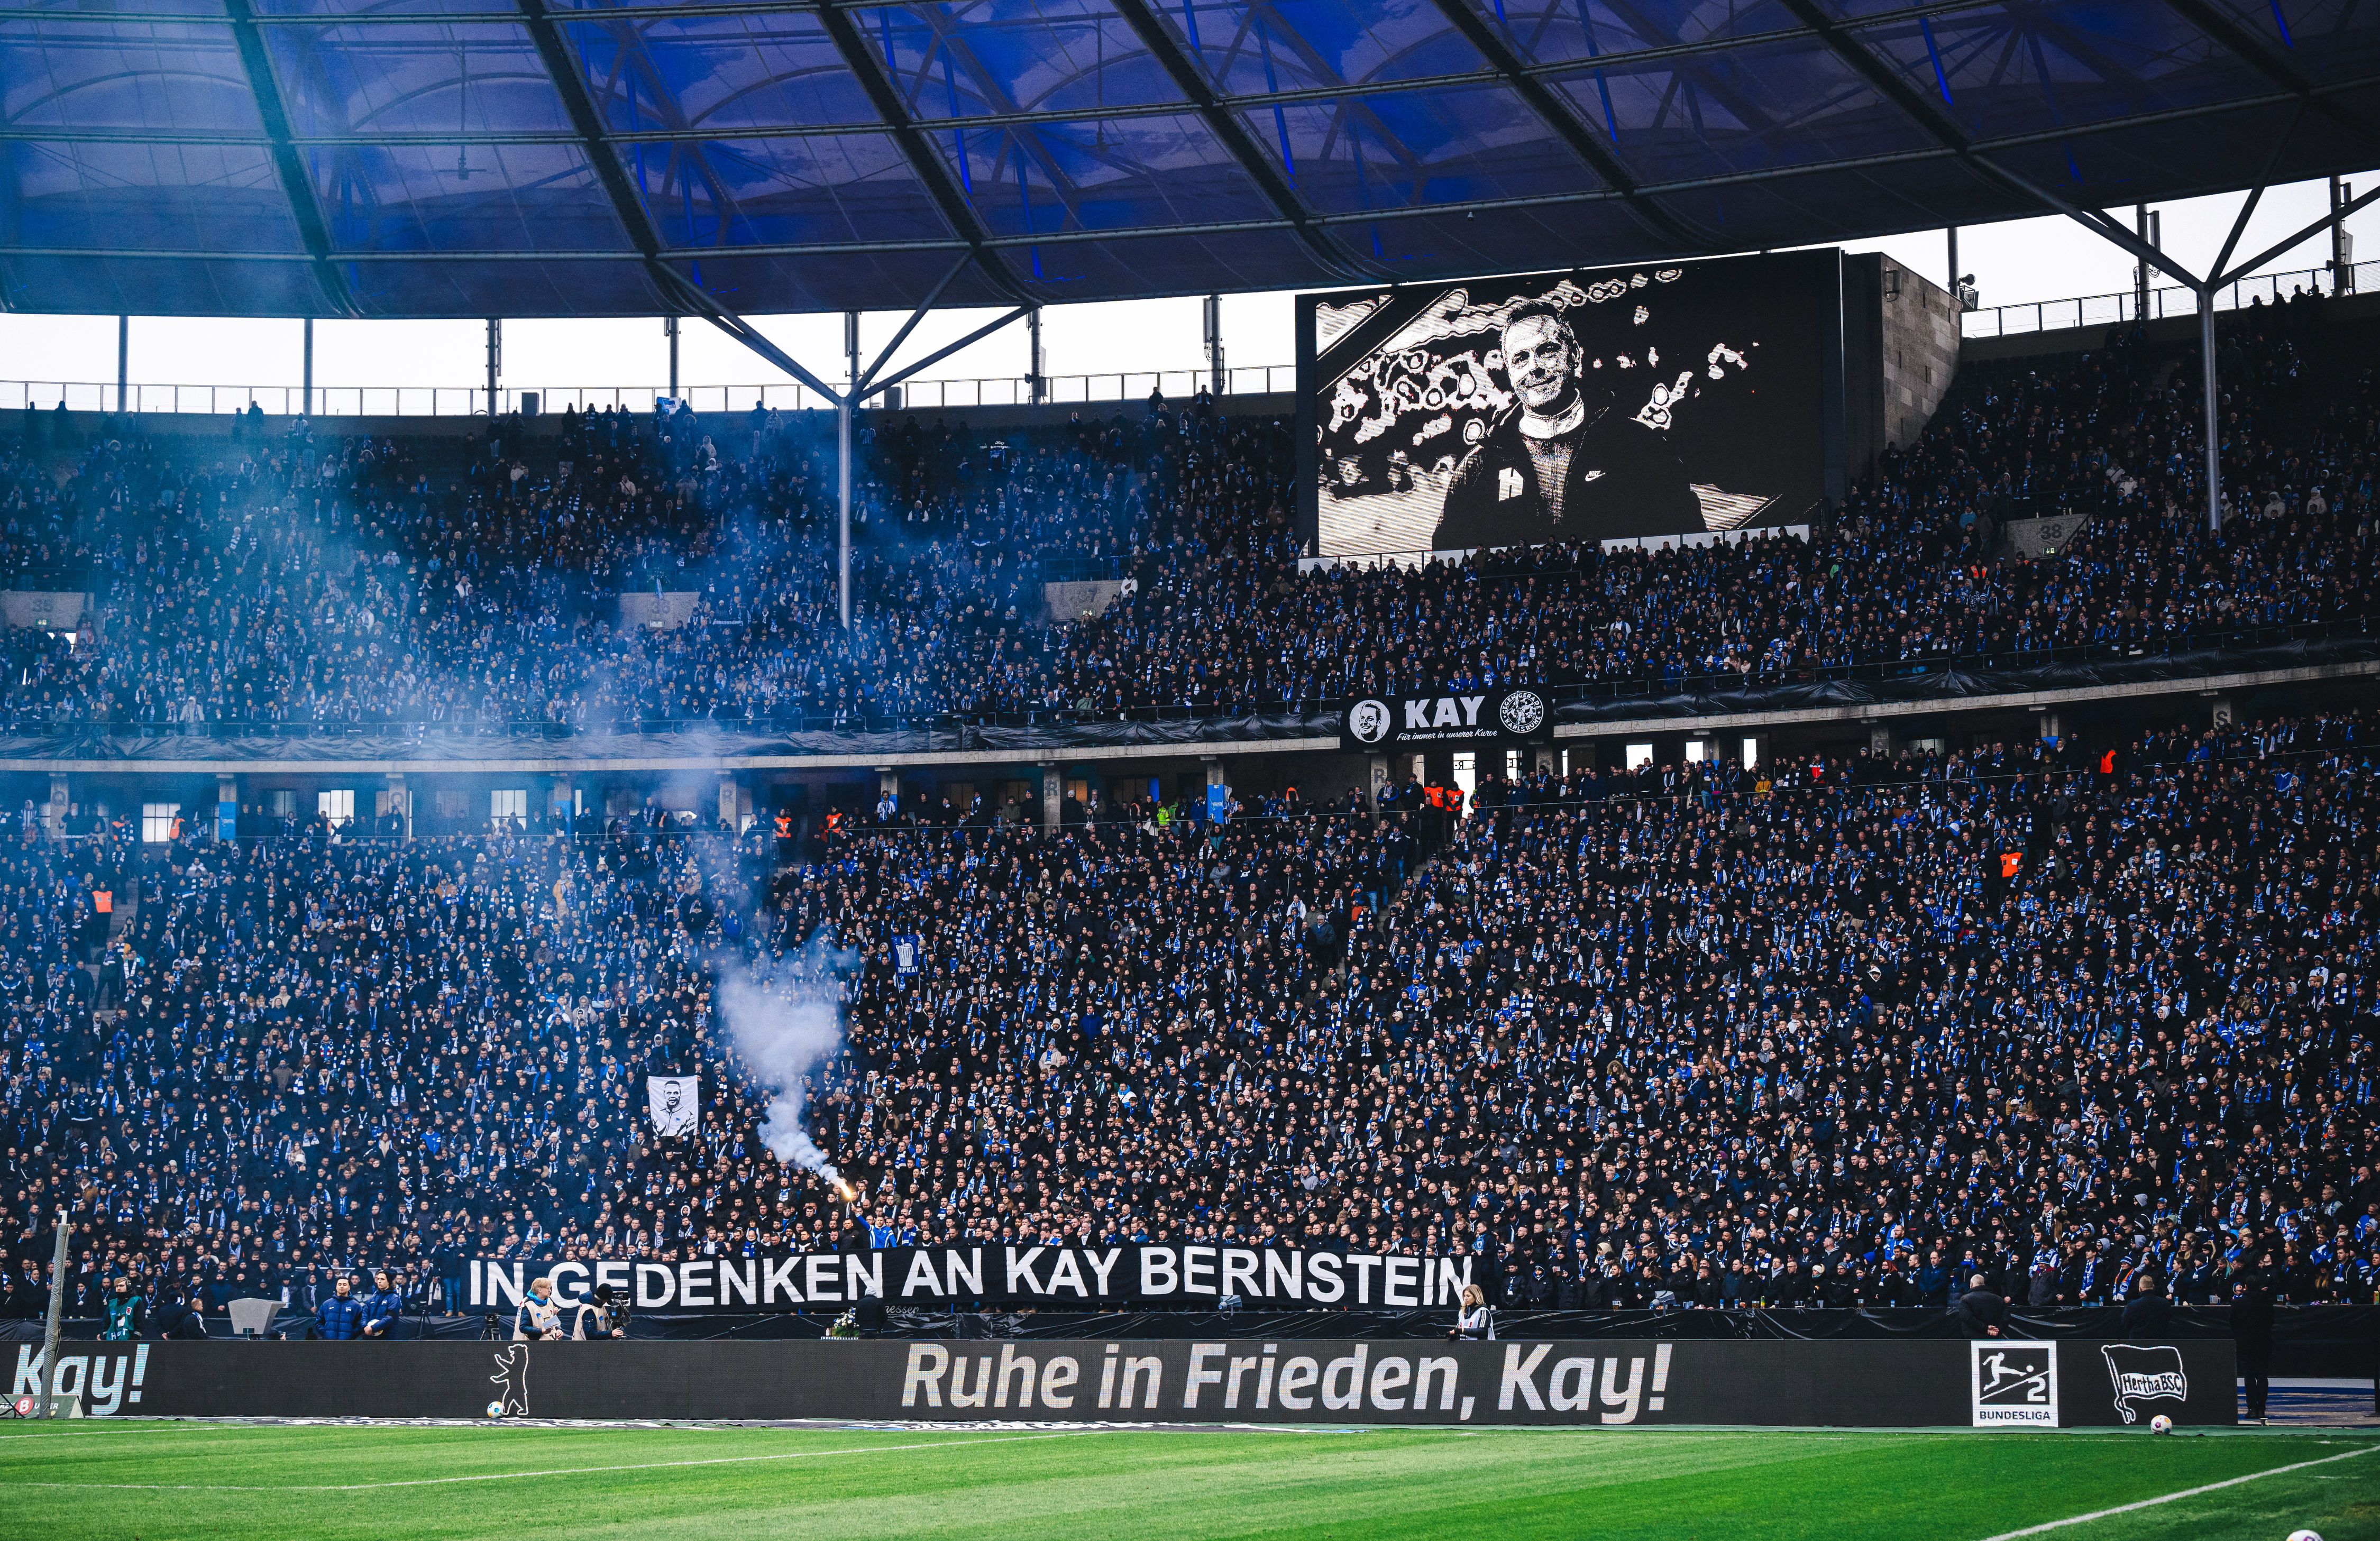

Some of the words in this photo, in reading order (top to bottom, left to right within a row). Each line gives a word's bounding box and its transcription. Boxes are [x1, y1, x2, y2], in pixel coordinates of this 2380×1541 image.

[2040, 524, 2062, 540] 38
[32, 599, 53, 612] 35
[1503, 693, 1519, 714] GEGEN
[1518, 693, 1541, 709] GERADE
[1405, 696, 1485, 729] KAY
[1505, 715, 1541, 731] KARLSRUHE
[1447, 729, 1473, 738] unserer
[1475, 728, 1497, 737] Kurve
[1374, 768, 1385, 784] R
[1046, 780, 1057, 796] R
[470, 1261, 524, 1306] IN
[548, 1253, 883, 1308] GEDENKEN
[902, 1248, 983, 1296] AN
[1006, 1247, 1121, 1297] KAY
[1141, 1247, 1472, 1306] BERNSTEIN
[13, 1344, 150, 1415] Kay!
[902, 1344, 1079, 1409] Ruhe
[1099, 1344, 1162, 1409] in
[1183, 1344, 1476, 1420] Frieden,
[1498, 1344, 1672, 1425] Kay!
[2027, 1376, 2046, 1401] 2
[1980, 1411, 2051, 1419] BUNDESLIGA
